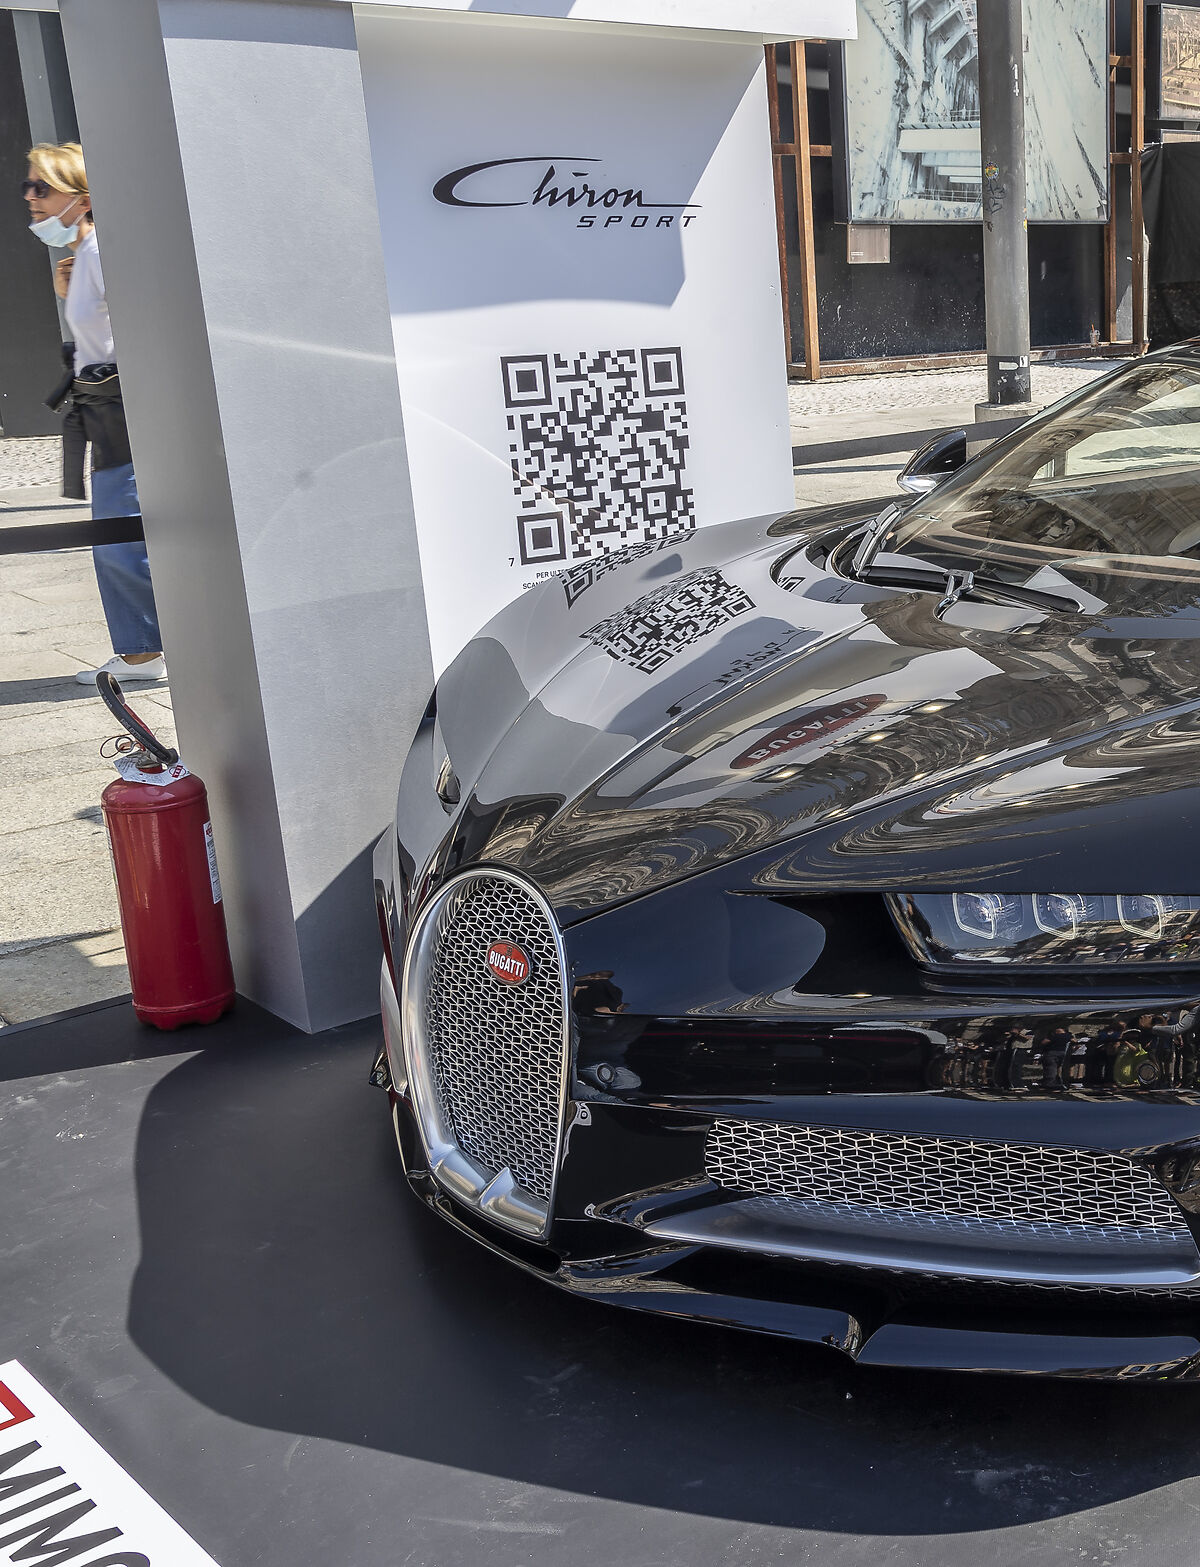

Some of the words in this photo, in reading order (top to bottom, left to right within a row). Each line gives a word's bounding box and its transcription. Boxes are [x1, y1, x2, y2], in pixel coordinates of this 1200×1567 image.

[432, 156, 703, 208] Chiron
[576, 215, 697, 228] SPORT
[508, 557, 515, 567] 7
[536, 571, 549, 579] PER
[489, 950, 525, 977] BUGATTI
